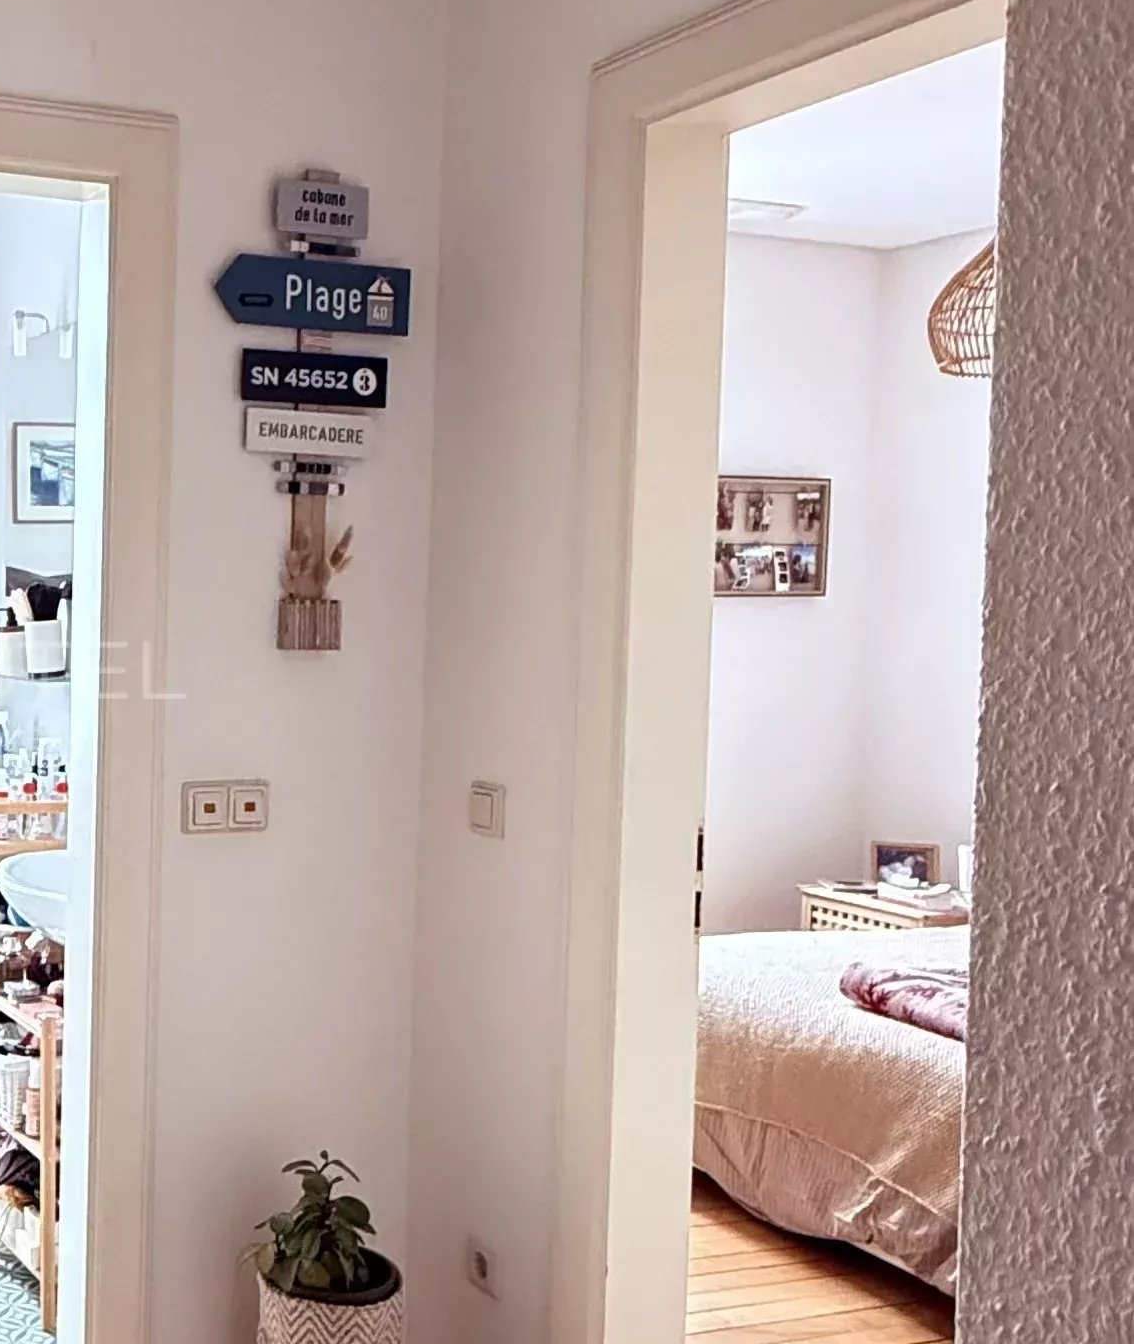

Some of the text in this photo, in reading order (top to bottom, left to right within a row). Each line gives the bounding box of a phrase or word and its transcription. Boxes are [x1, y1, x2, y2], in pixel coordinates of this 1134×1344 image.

[302, 188, 346, 207] cabane
[295, 206, 354, 226] de la mer
[286, 273, 362, 321] Plage
[250, 365, 279, 387] SN
[283, 367, 348, 390] 45652
[258, 420, 364, 445] EMBARCADERE
